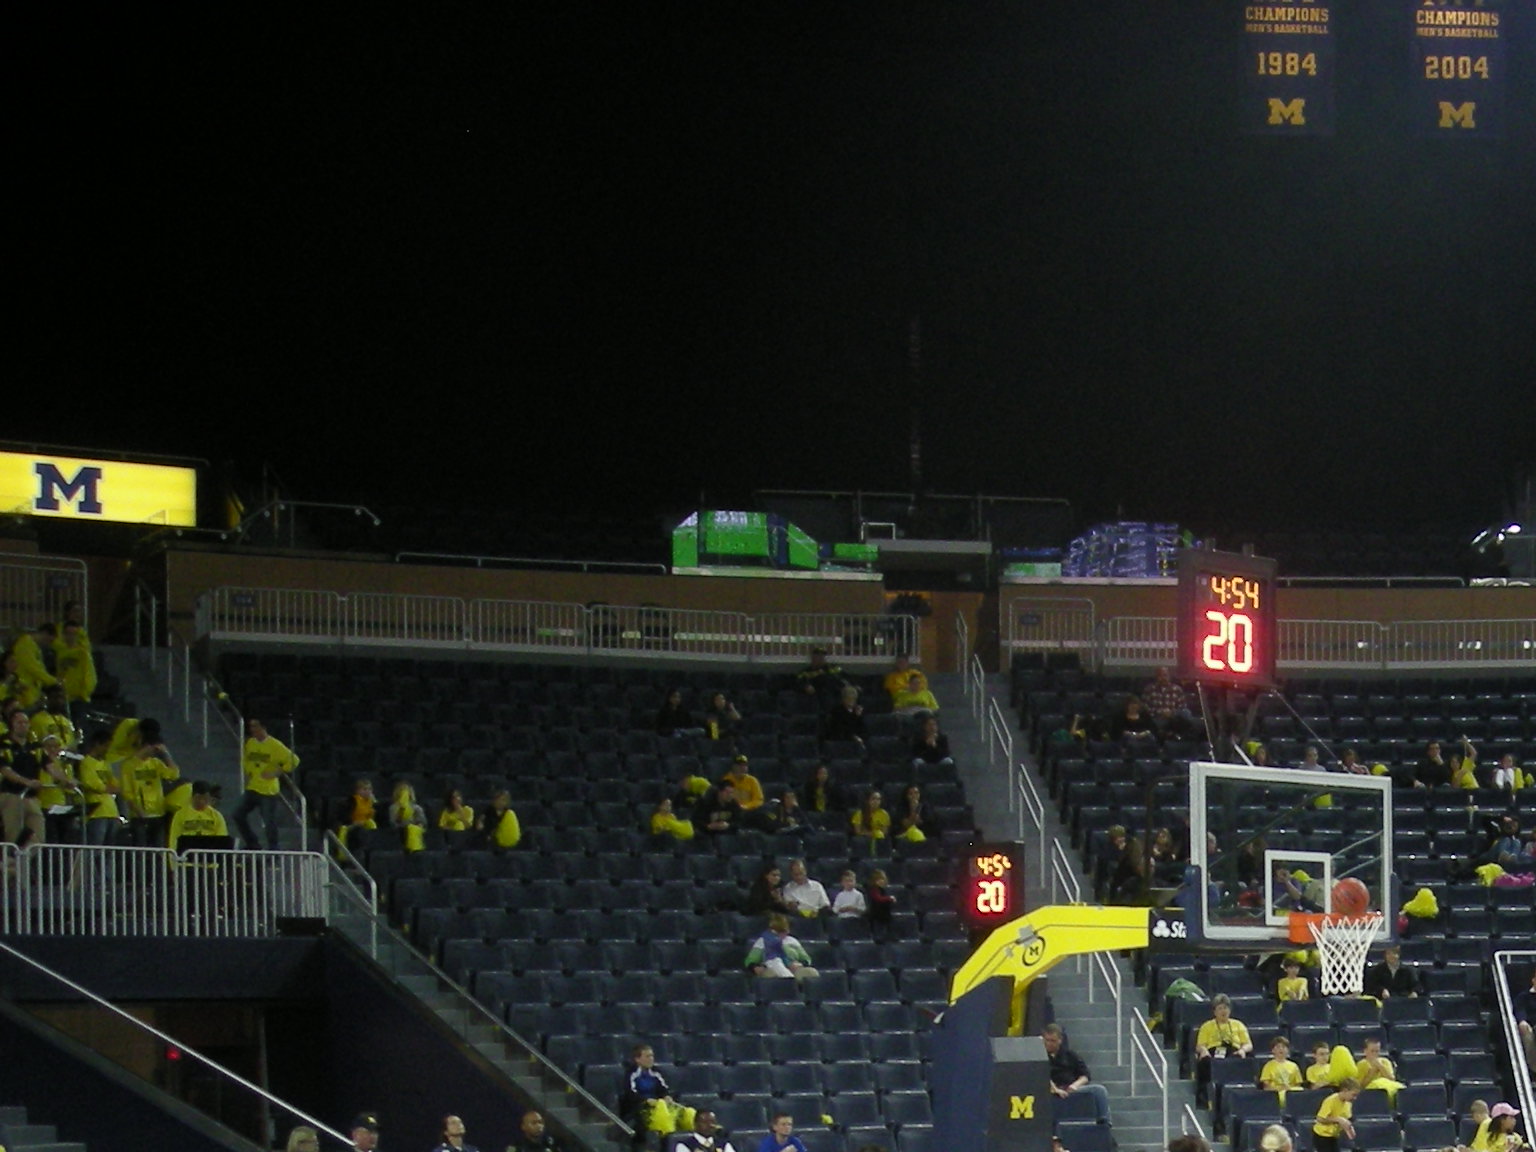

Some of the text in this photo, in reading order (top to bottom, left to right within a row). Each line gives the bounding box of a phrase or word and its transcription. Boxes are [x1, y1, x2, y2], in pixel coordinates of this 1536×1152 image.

[1245, 7, 1329, 22] CHAMPIONS
[1416, 10, 1500, 26] CHAMPIONS
[1258, 53, 1317, 76] 1984
[1425, 56, 1488, 80] 2004
[1268, 99, 1306, 125] M
[1439, 102, 1475, 128] M
[35, 463, 102, 514] M
[1211, 576, 1259, 609] 4:54
[1203, 610, 1253, 673] 20
[977, 881, 1005, 912] 20
[1010, 1096, 1035, 1119] M
